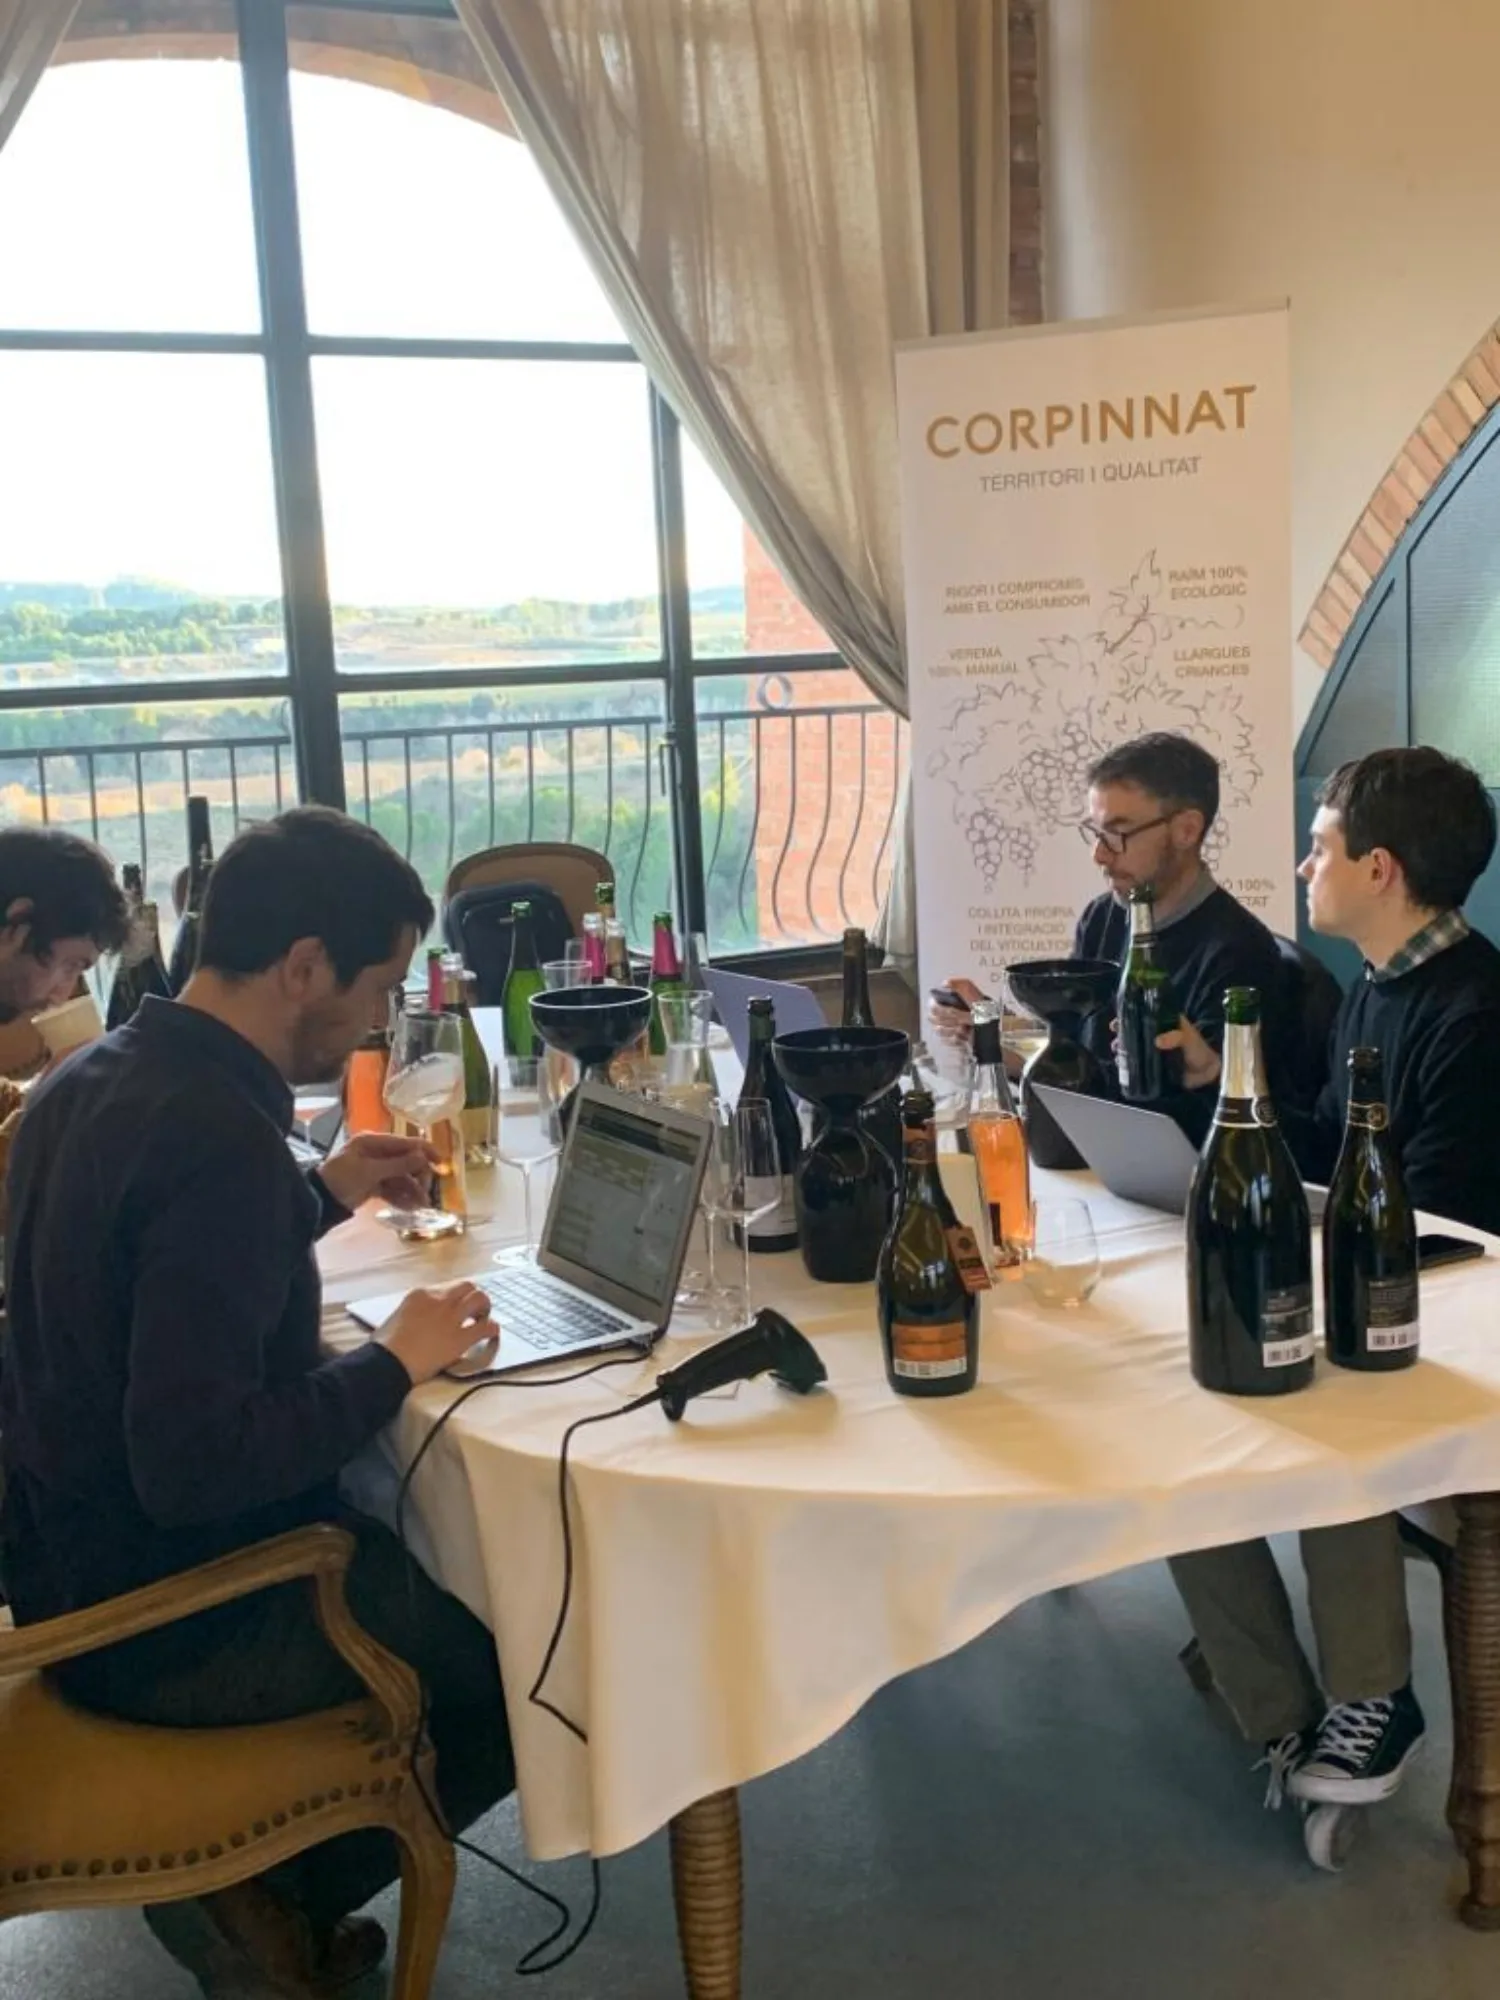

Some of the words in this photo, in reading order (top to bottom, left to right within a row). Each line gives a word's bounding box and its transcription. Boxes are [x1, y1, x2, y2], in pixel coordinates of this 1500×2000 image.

[926, 385, 1256, 458] CORPINNAT
[979, 467, 1084, 492] TERRITORI
[1102, 455, 1202, 482] QUALITAT
[1209, 565, 1248, 579] 100%
[945, 584, 988, 598] RIGOR
[943, 601, 973, 614] AMB
[978, 600, 993, 613] EL
[995, 595, 1090, 612] CONSUMIDOR
[949, 645, 1003, 661] VEREMA
[1173, 645, 1251, 662] LLARGUES
[965, 661, 1018, 675] MANUAL
[1174, 663, 1250, 679] CRIANCES
[968, 905, 1020, 918] COLLITA
[970, 940, 992, 952] DEL
